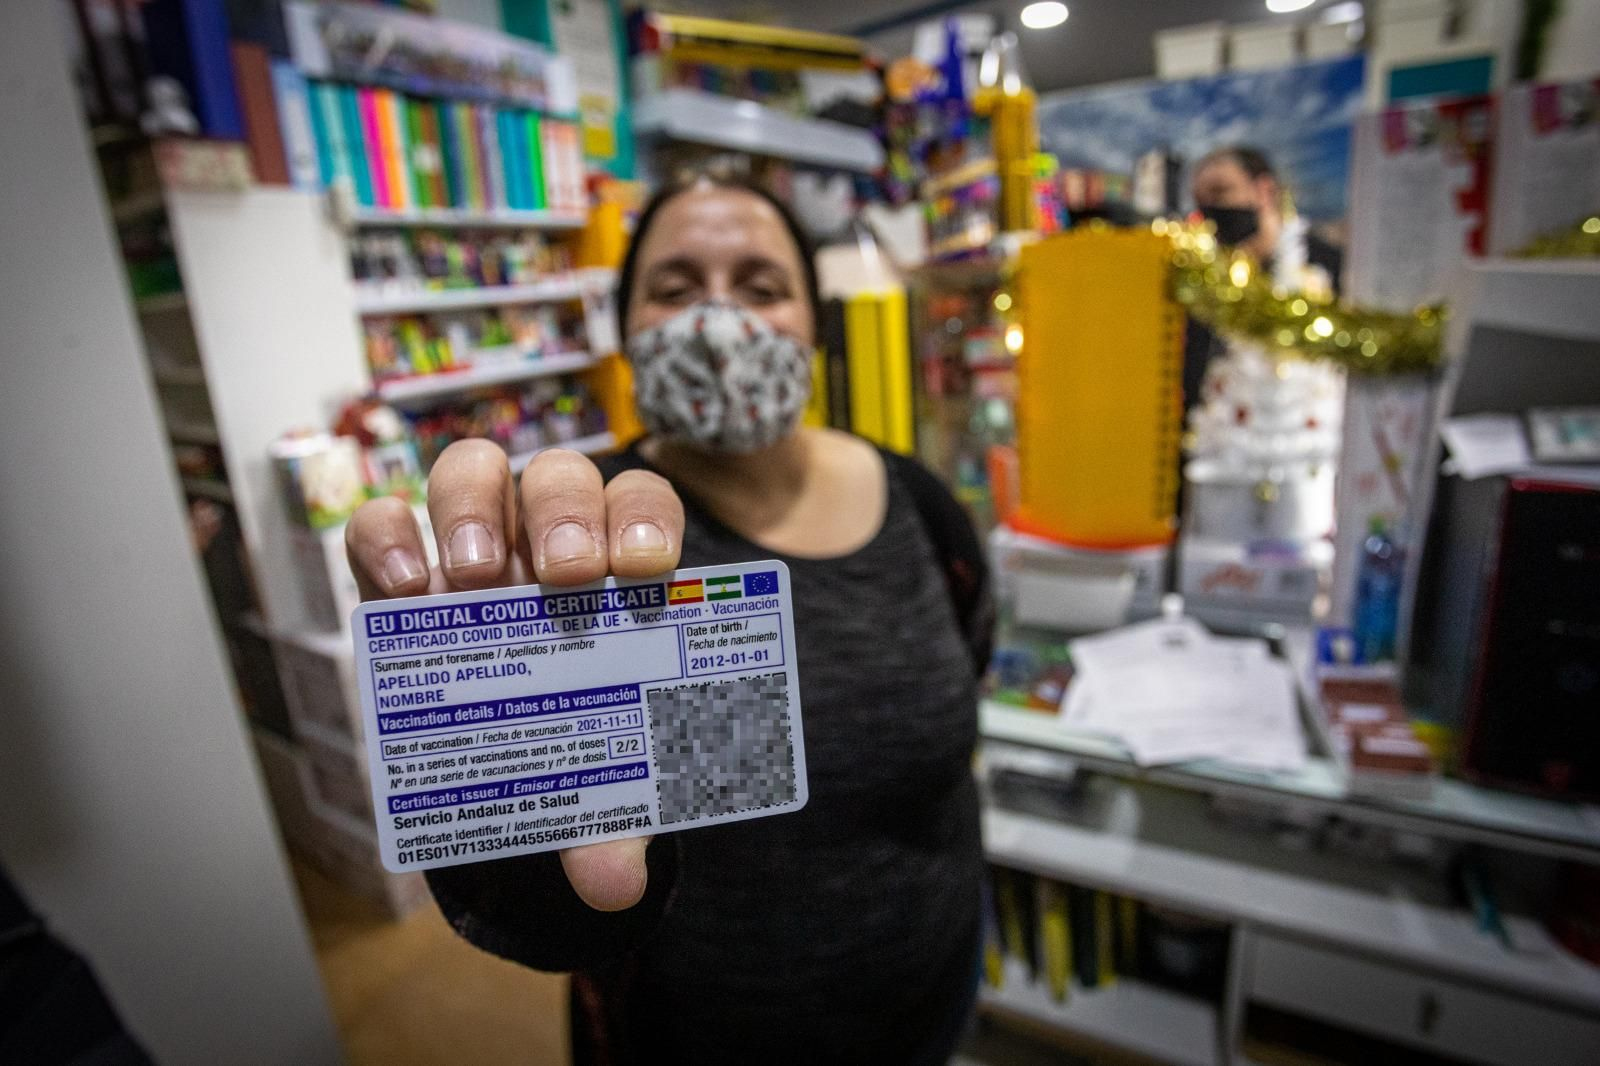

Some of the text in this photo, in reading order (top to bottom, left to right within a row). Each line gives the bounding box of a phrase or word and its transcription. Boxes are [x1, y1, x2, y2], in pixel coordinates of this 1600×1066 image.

[368, 631, 458, 653] CERTIFICADO
[462, 627, 502, 643] COVID
[506, 619, 559, 638] DIGITAL
[562, 618, 580, 632] DE
[582, 615, 599, 630] LA
[603, 614, 620, 628] UE
[631, 607, 701, 624] Vaccination
[711, 596, 779, 615] Vacunación
[369, 587, 659, 634] EU DIGITAL COVID CERTIFICATE
[686, 619, 749, 637] Date of birth /
[374, 639, 595, 672] Surname and forename / Apellidos y nombre
[688, 631, 778, 650] Fecha de nacimiento
[378, 662, 531, 691] APELLIDO APELLIDO,
[691, 649, 768, 670] 2012-01-01
[379, 689, 445, 708] NOMBRE
[380, 687, 637, 730] Vaccination details / Datos de la vacunación
[384, 713, 638, 756] Date of vaccination / Fecha de vacunación 2021-11-11
[616, 739, 639, 753] 2/2
[387, 738, 606, 775] No. in a series of vaccinations and no. of doses
[404, 777, 417, 788] en
[419, 775, 438, 786] una
[440, 771, 464, 783] serie
[466, 768, 479, 779] de
[481, 760, 546, 777] vacunaciones
[548, 759, 554, 769] y
[568, 755, 580, 765] de
[582, 751, 607, 764] dosis
[392, 766, 645, 810] Certificate issuer / Emisor del certificado
[393, 792, 579, 830] Servicio Andaluz de Salud
[396, 803, 649, 849] Certificate identifier / Identificador del certificado
[398, 815, 652, 864] 01ES01V71333444555666777888F#A
